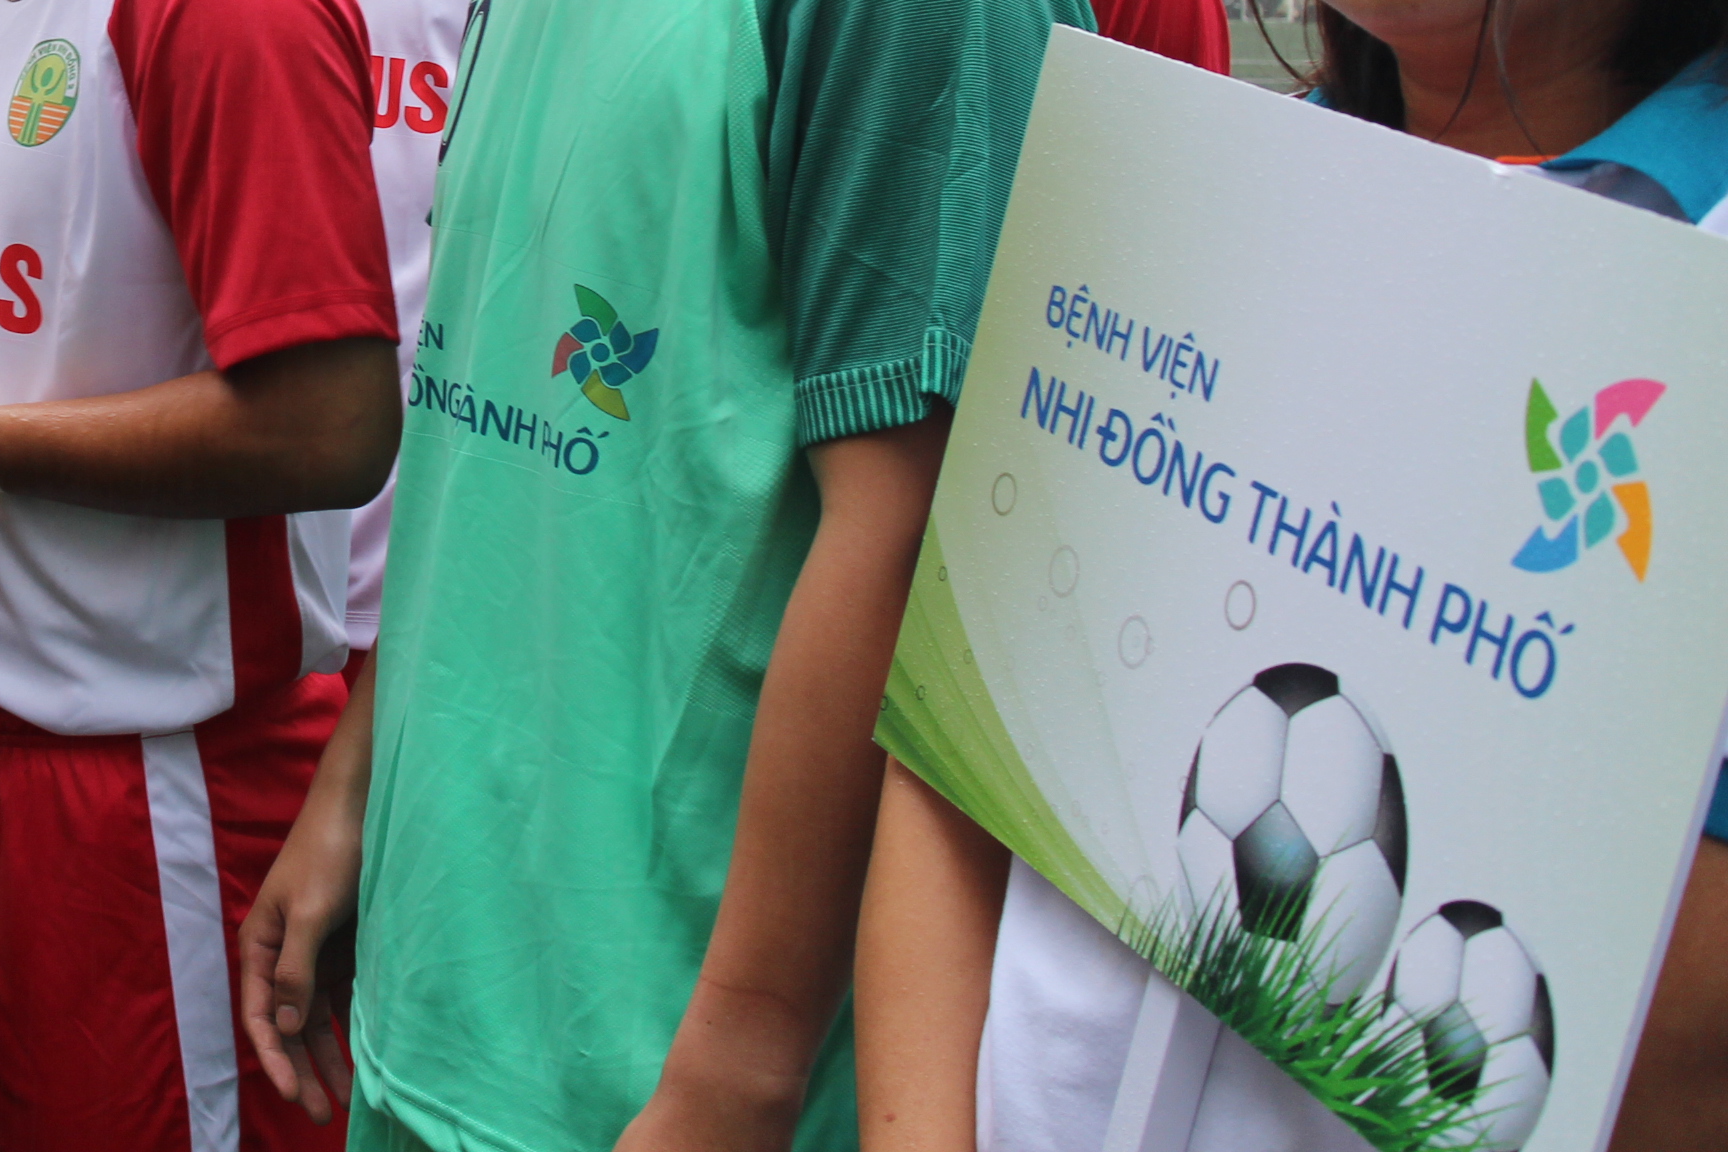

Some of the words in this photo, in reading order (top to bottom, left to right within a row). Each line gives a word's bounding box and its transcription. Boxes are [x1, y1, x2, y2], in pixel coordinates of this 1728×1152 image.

[1046, 284, 1133, 361] BỆNH
[1141, 327, 1220, 402] VIỆN
[1020, 366, 1096, 450] NHI
[1096, 408, 1236, 525] ĐỒNG
[1248, 479, 1425, 630] THÀNH
[1429, 582, 1577, 700] PHỐ
